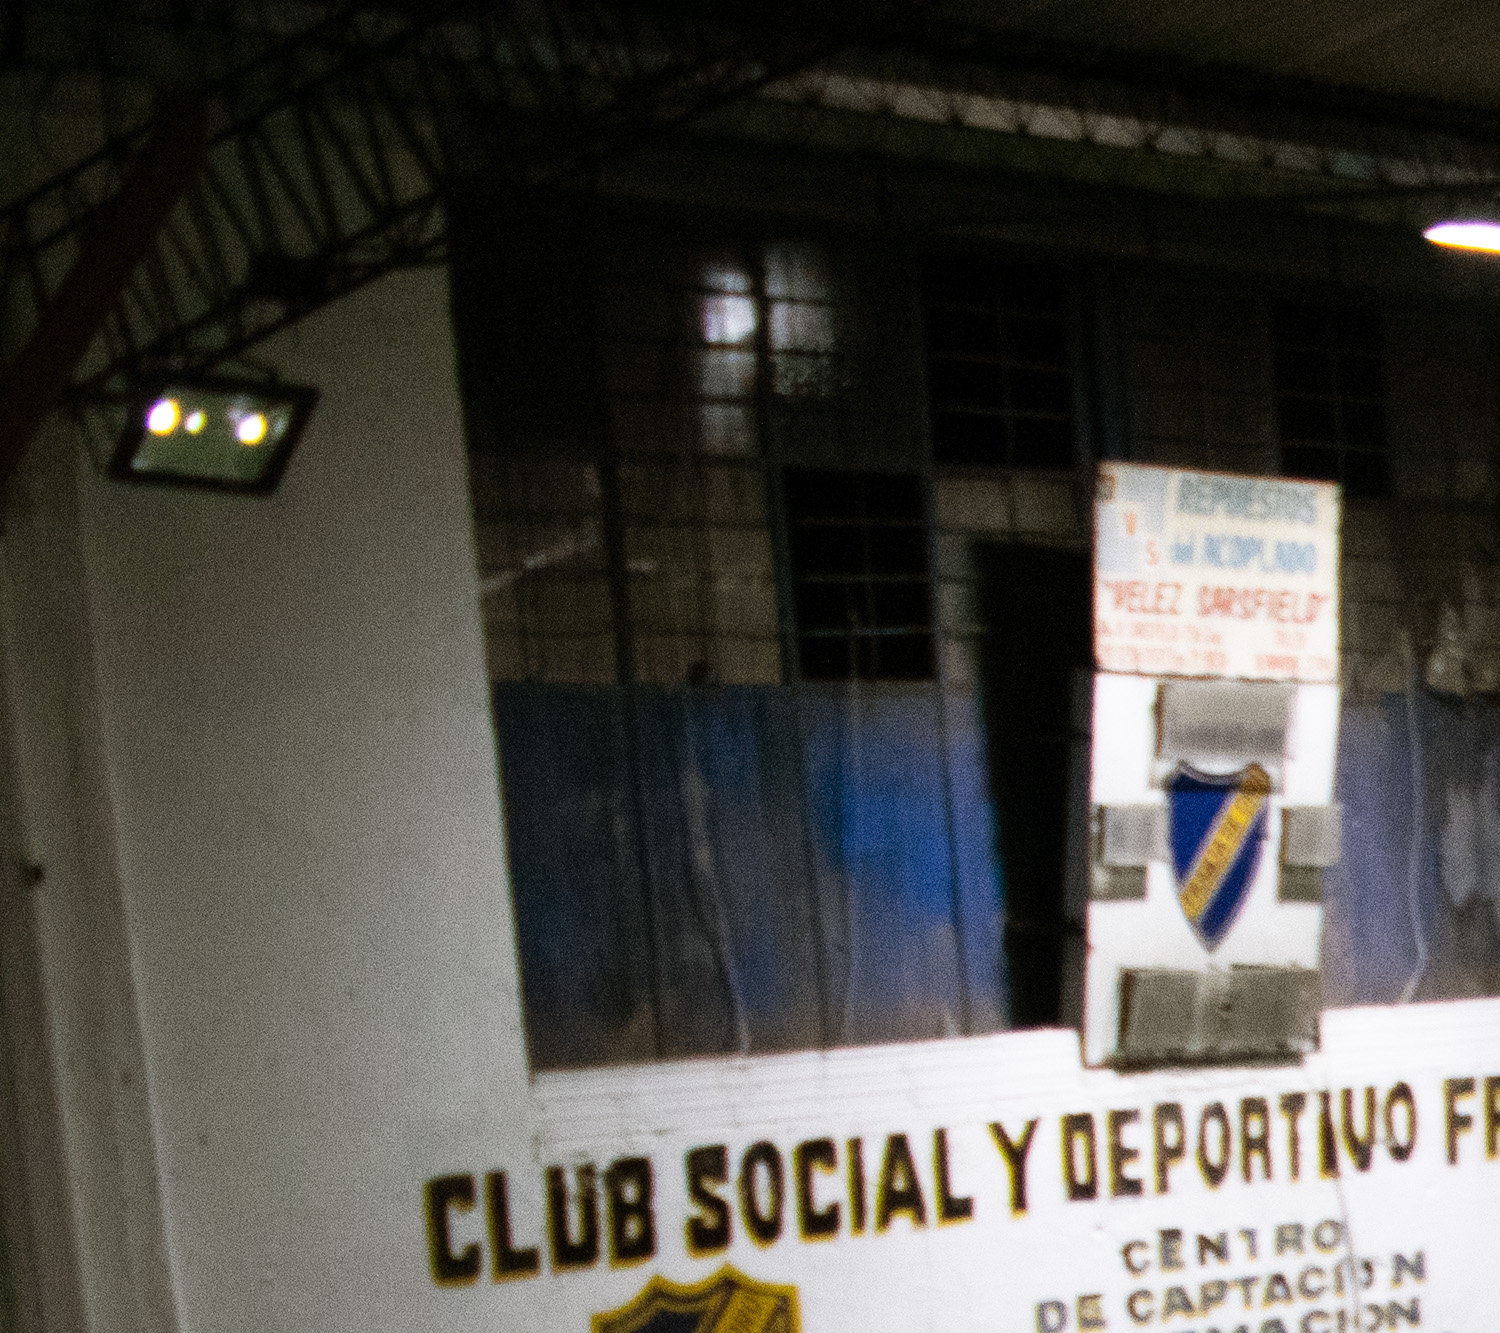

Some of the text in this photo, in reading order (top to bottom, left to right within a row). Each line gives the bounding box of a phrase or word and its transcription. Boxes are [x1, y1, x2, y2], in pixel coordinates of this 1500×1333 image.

[424, 1157, 655, 1284] CLUB
[684, 1128, 972, 1256] SOCIAL
[988, 1116, 1040, 1216] Y
[1060, 1081, 1418, 1201] DEPORTIVO
[1121, 1218, 1342, 1278] CENTRO
